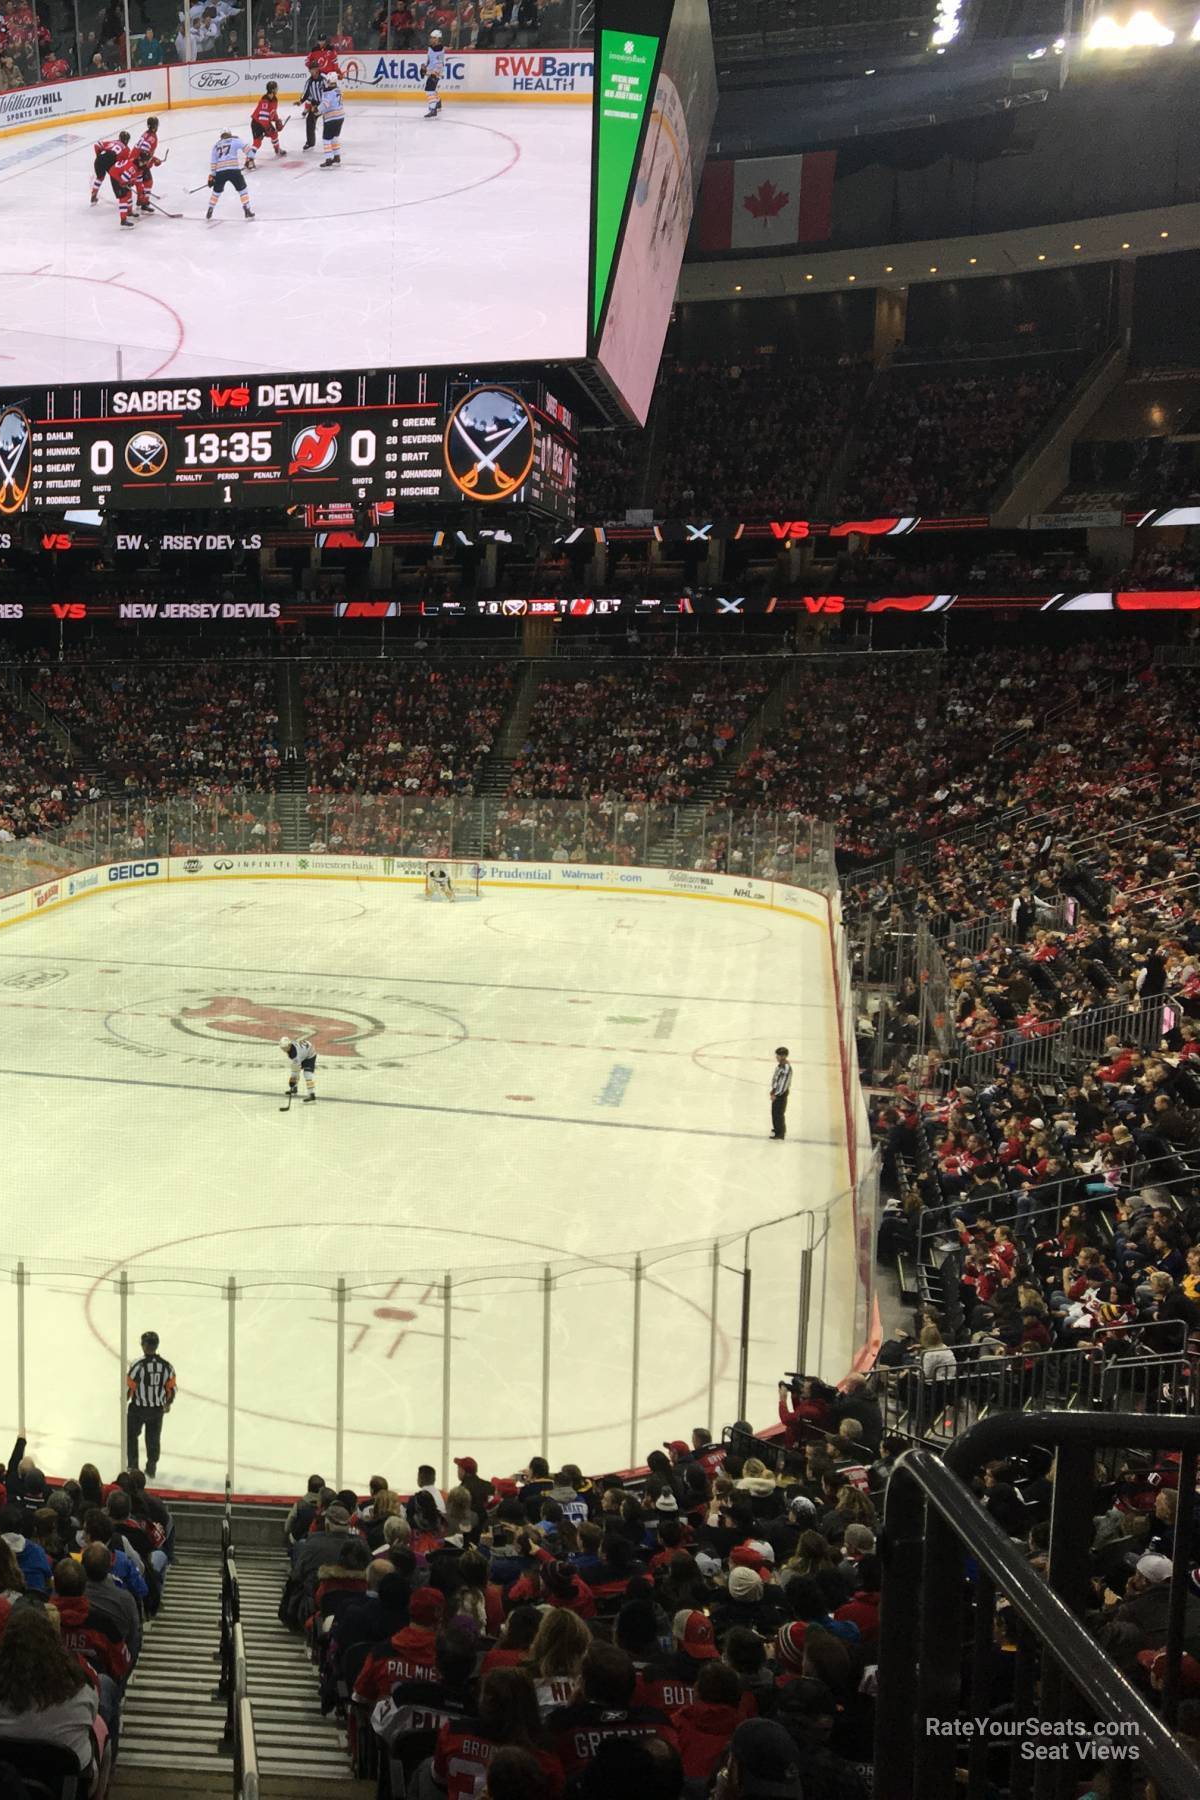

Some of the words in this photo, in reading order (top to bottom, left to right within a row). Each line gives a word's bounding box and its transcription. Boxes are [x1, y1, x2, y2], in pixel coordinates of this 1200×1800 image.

[197, 72, 231, 88] Ford
[244, 71, 307, 81] BuyFordNow.com
[513, 77, 575, 91] HEALTH
[43, 91, 63, 103] HILL
[6, 109, 32, 121] SPORTS
[113, 388, 202, 414] SABRES
[210, 388, 250, 408] VS
[257, 381, 343, 406] DEVILS
[402, 417, 437, 427] GREENE
[46, 431, 74, 441] DAHLIN
[402, 434, 443, 444] SEVERSON
[46, 446, 81, 457] HUNWICK
[184, 431, 272, 465] 13:35
[350, 429, 376, 466] 0
[91, 439, 114, 475] 0
[385, 452, 398, 461] 63
[401, 451, 430, 461] BRATT
[32, 463, 43, 473] 43
[46, 463, 75, 473] SHEARY
[400, 469, 442, 479] JOHANSSON
[176, 473, 202, 482] PENALTY
[217, 472, 239, 480] PERIOD
[253, 471, 281, 479] PENALTY
[352, 477, 373, 485] SHOTS
[33, 480, 43, 489] 37
[92, 484, 111, 493] SHOTS
[223, 486, 232, 503] 1
[358, 488, 366, 498] 5
[386, 487, 397, 496] 13
[400, 486, 440, 496] HISCHIER
[34, 496, 43, 505] 71
[46, 496, 81, 505] RODRIGUES
[770, 521, 809, 538] VS
[41, 533, 72, 549] VS
[116, 534, 142, 550] EW
[120, 603, 159, 618] NEW
[160, 603, 221, 618] JERSEY
[222, 603, 281, 618] DEVILS
[531, 602, 556, 612] 13:35
[803, 596, 846, 613] VS
[51, 603, 86, 619] VS
[237, 861, 291, 869] INFINITI
[107, 861, 160, 882] GEICO
[490, 865, 552, 881] Prudential
[561, 869, 604, 881] Walmart
[619, 873, 642, 883] com
[149, 1371, 161, 1386] 10
